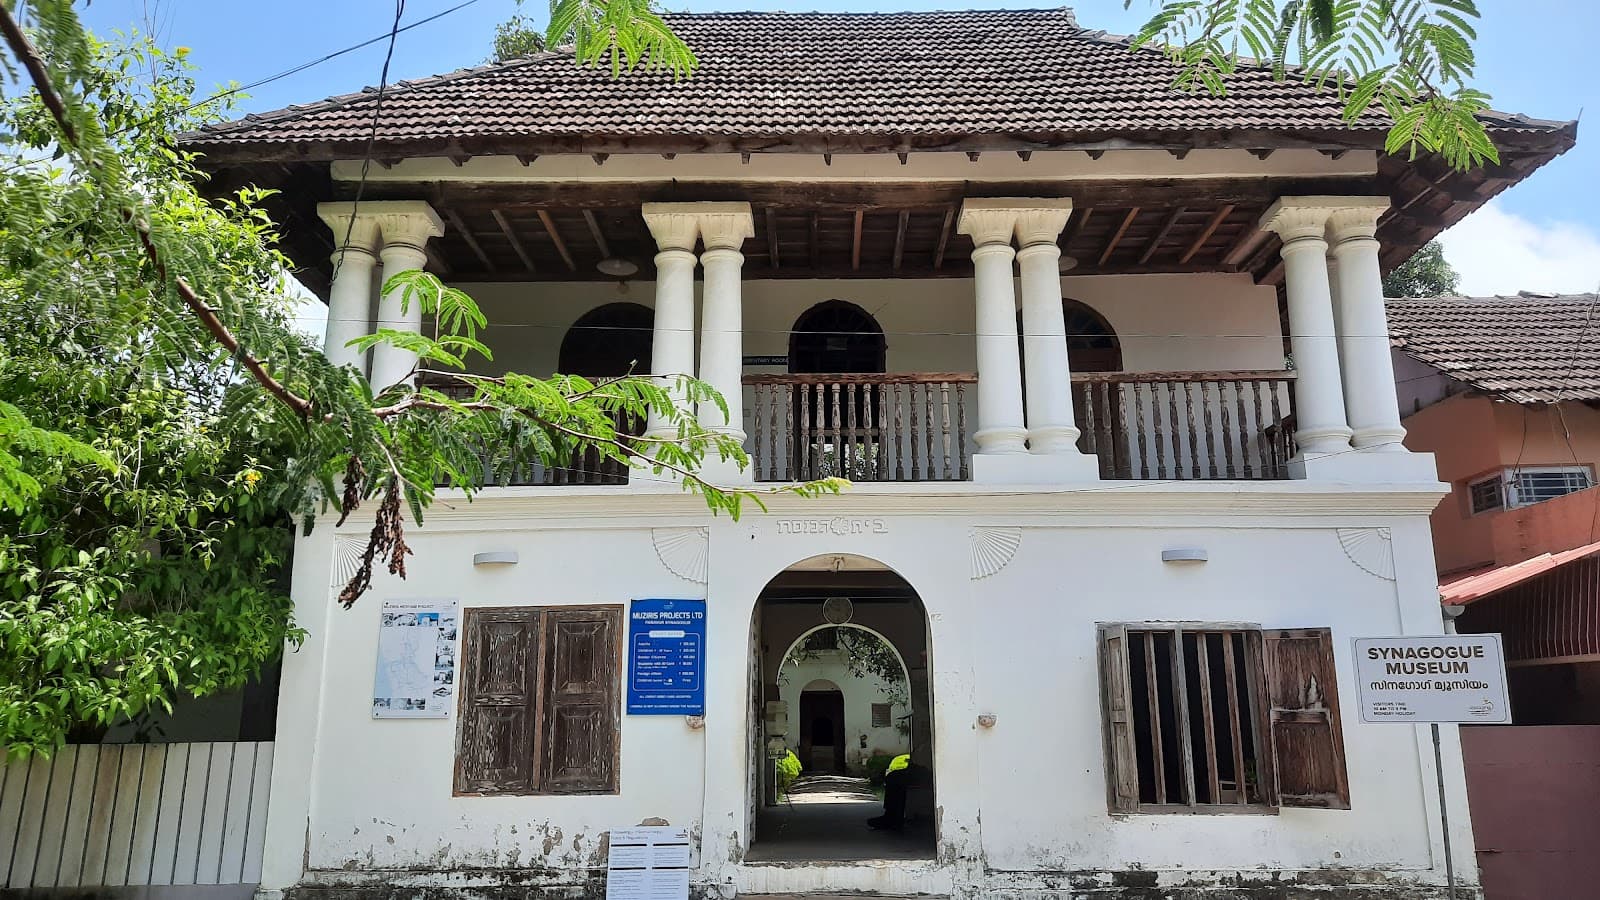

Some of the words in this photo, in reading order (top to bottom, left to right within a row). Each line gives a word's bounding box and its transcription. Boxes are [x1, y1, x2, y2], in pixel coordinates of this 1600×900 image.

[691, 611, 703, 619] LTD
[1367, 645, 1484, 660] SYNAGOGUE
[1385, 661, 1469, 675] MUSEUM
